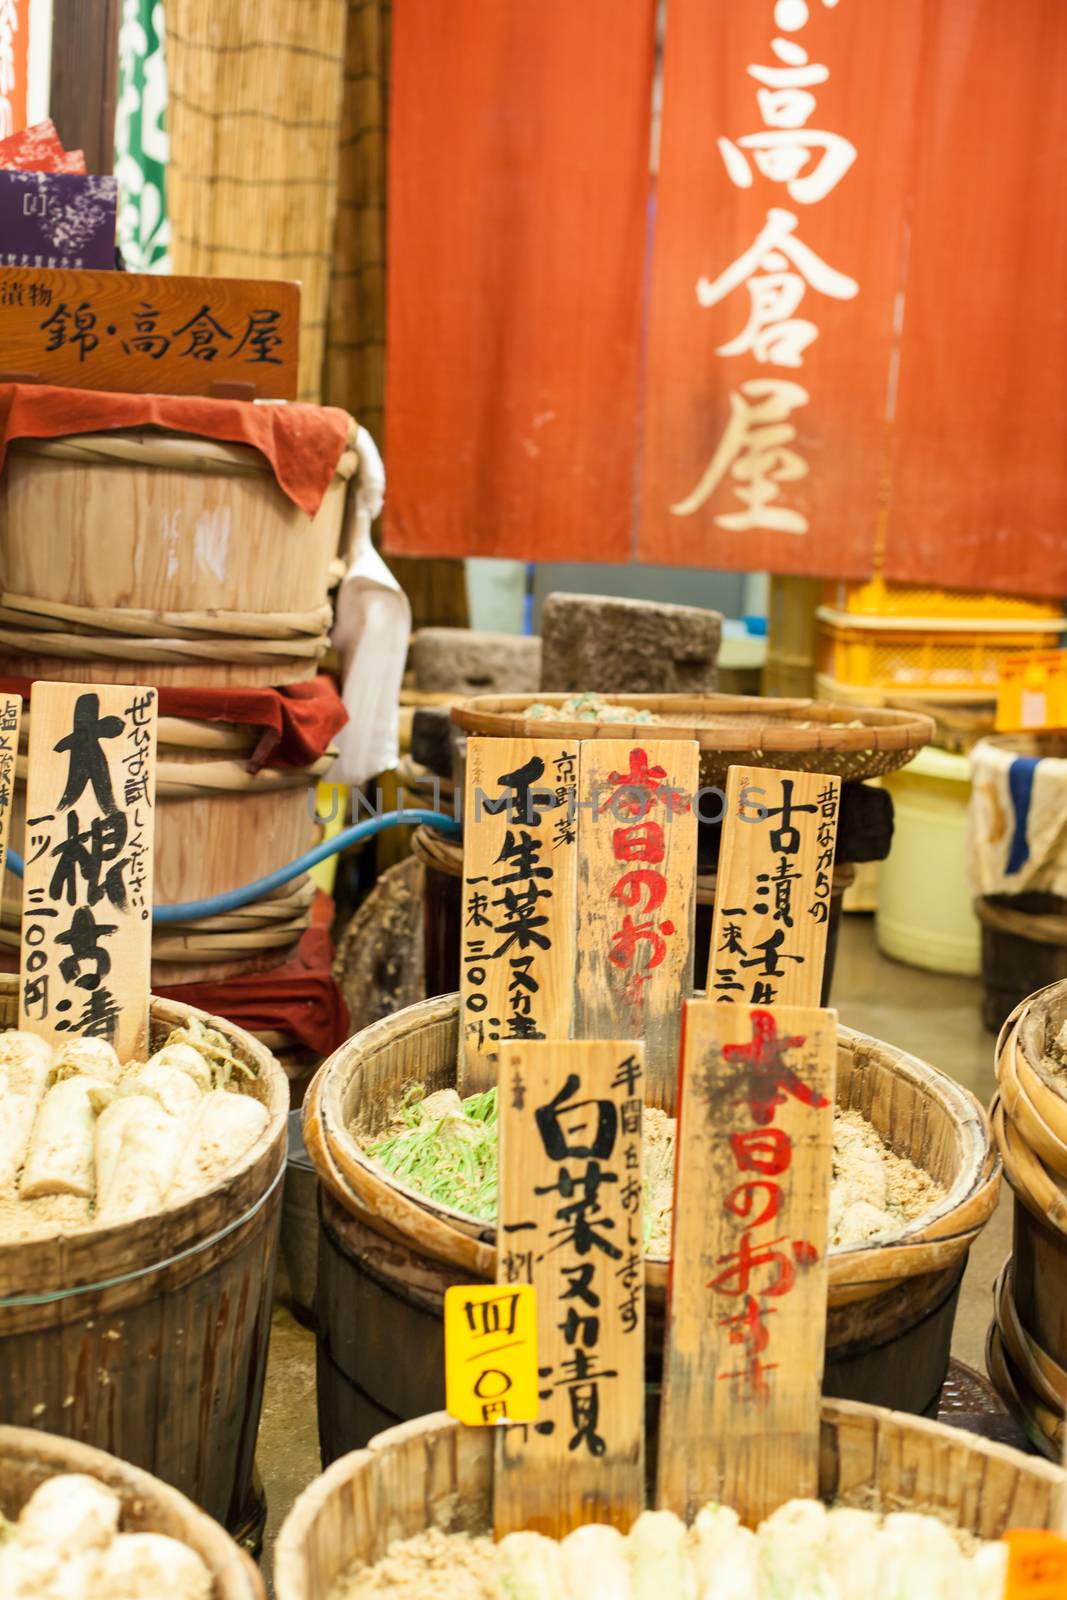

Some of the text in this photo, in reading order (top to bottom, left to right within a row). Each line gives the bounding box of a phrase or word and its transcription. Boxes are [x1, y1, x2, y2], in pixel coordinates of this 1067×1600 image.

[1, 280, 52, 306] 漬物
[40, 301, 284, 364] 錦・高倉屋
[552, 750, 577, 850] 京野菜
[807, 781, 839, 923] 昔ながらの
